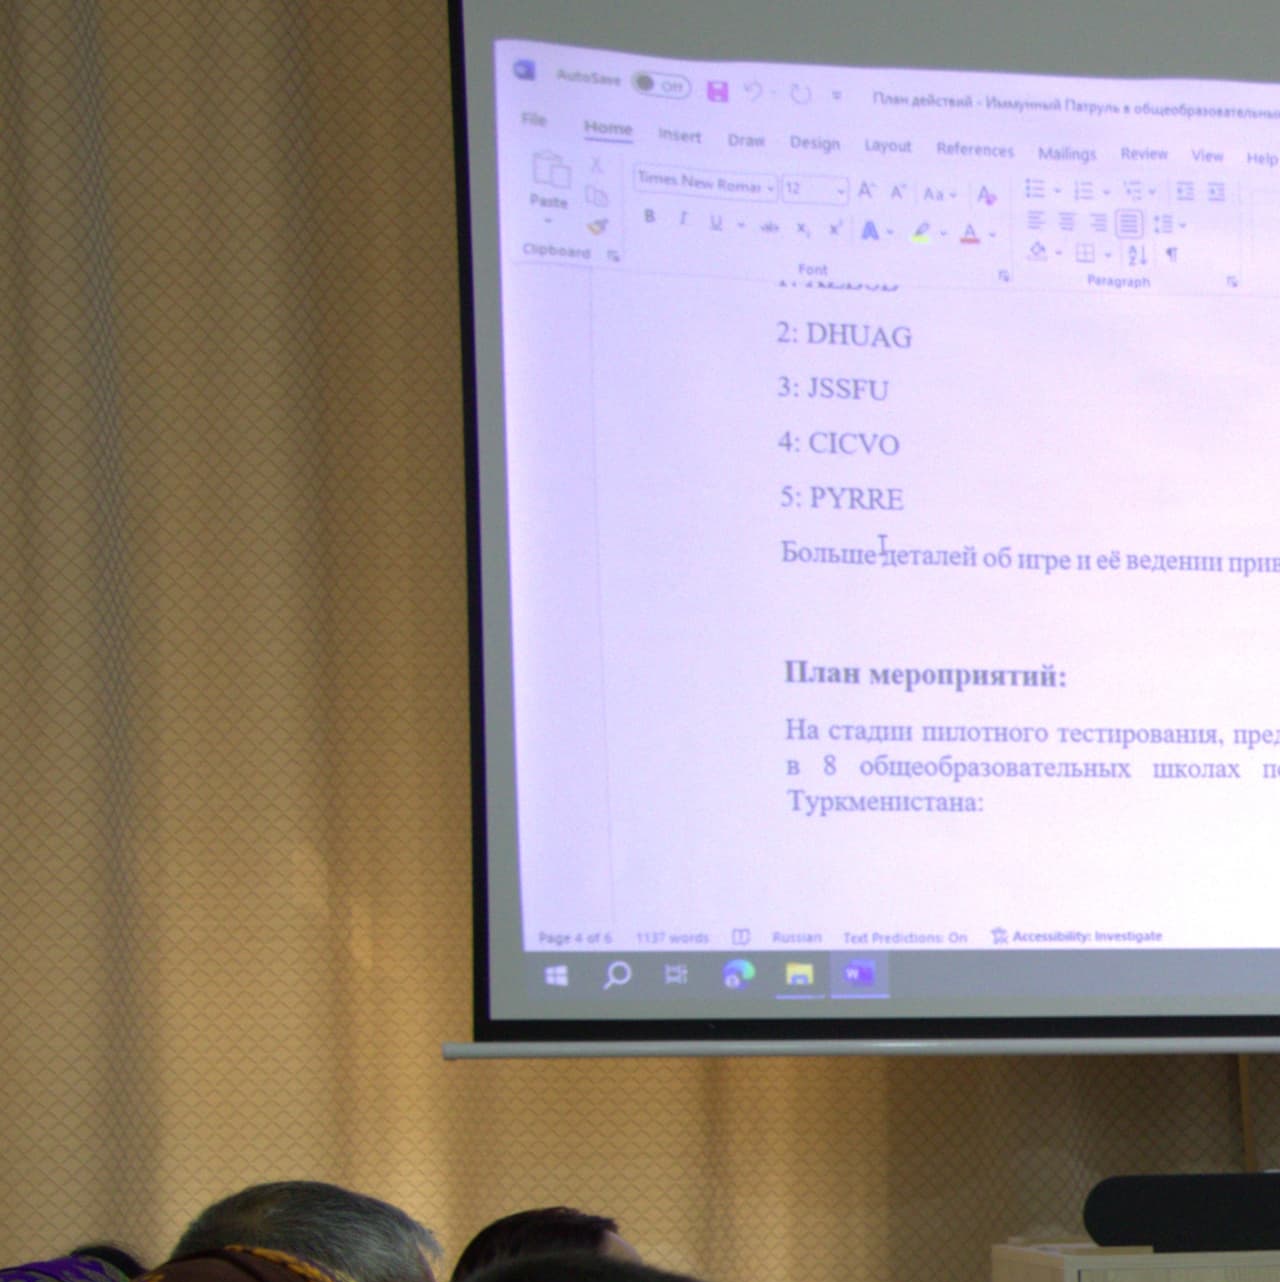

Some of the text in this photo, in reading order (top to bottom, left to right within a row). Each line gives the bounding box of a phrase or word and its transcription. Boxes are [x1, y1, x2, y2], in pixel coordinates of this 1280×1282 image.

[556, 69, 684, 92] AutoSave Off
[872, 90, 909, 107] План
[911, 93, 973, 111] действий
[985, 96, 1062, 114] Иммунный
[1065, 99, 1121, 118] Патруль
[521, 112, 547, 127] File
[584, 120, 633, 136] Home
[658, 127, 702, 144] Insert
[727, 133, 766, 148] Draw
[789, 134, 841, 154] Design
[864, 138, 913, 156] Layout
[936, 141, 1016, 159] References
[1037, 147, 1097, 165] Mailings
[1120, 147, 1169, 161] Review
[1191, 149, 1224, 163] View
[1246, 151, 1280, 168] Help
[637, 169, 679, 187] Times
[680, 173, 715, 190] New
[785, 181, 801, 195] 12
[529, 192, 569, 211] Paste
[522, 242, 592, 260] Clipboard
[798, 262, 829, 277] Font
[1086, 273, 1151, 291] Paragraph
[777, 322, 913, 350] 2: DHUAG
[778, 376, 890, 402] 3: JSSFU
[778, 431, 900, 457] 4: CICVO
[781, 486, 904, 511] 5: PYRRE
[781, 541, 877, 565] Больше
[881, 545, 978, 568] деталей
[983, 547, 1012, 569] об
[1018, 552, 1072, 575] игре
[1077, 553, 1091, 570] и
[1097, 550, 1121, 570] её
[1127, 553, 1223, 574] ведении
[785, 660, 1067, 692] План мероприятий:
[785, 718, 819, 741] На
[828, 723, 913, 745] стадии
[922, 725, 1048, 745] пилотного
[1057, 725, 1224, 748] тестирования,
[787, 760, 800, 776] в
[823, 754, 837, 776] 8
[860, 756, 1131, 781] общеобразовательных
[1153, 762, 1241, 779] школах
[787, 789, 984, 817] Туркменистана:
[538, 933, 573, 946] Page
[670, 932, 709, 944] words
[772, 931, 822, 944] Russian
[843, 931, 968, 944] Text Predictions: On
[1012, 930, 1163, 945] Accessibility: Investigate
